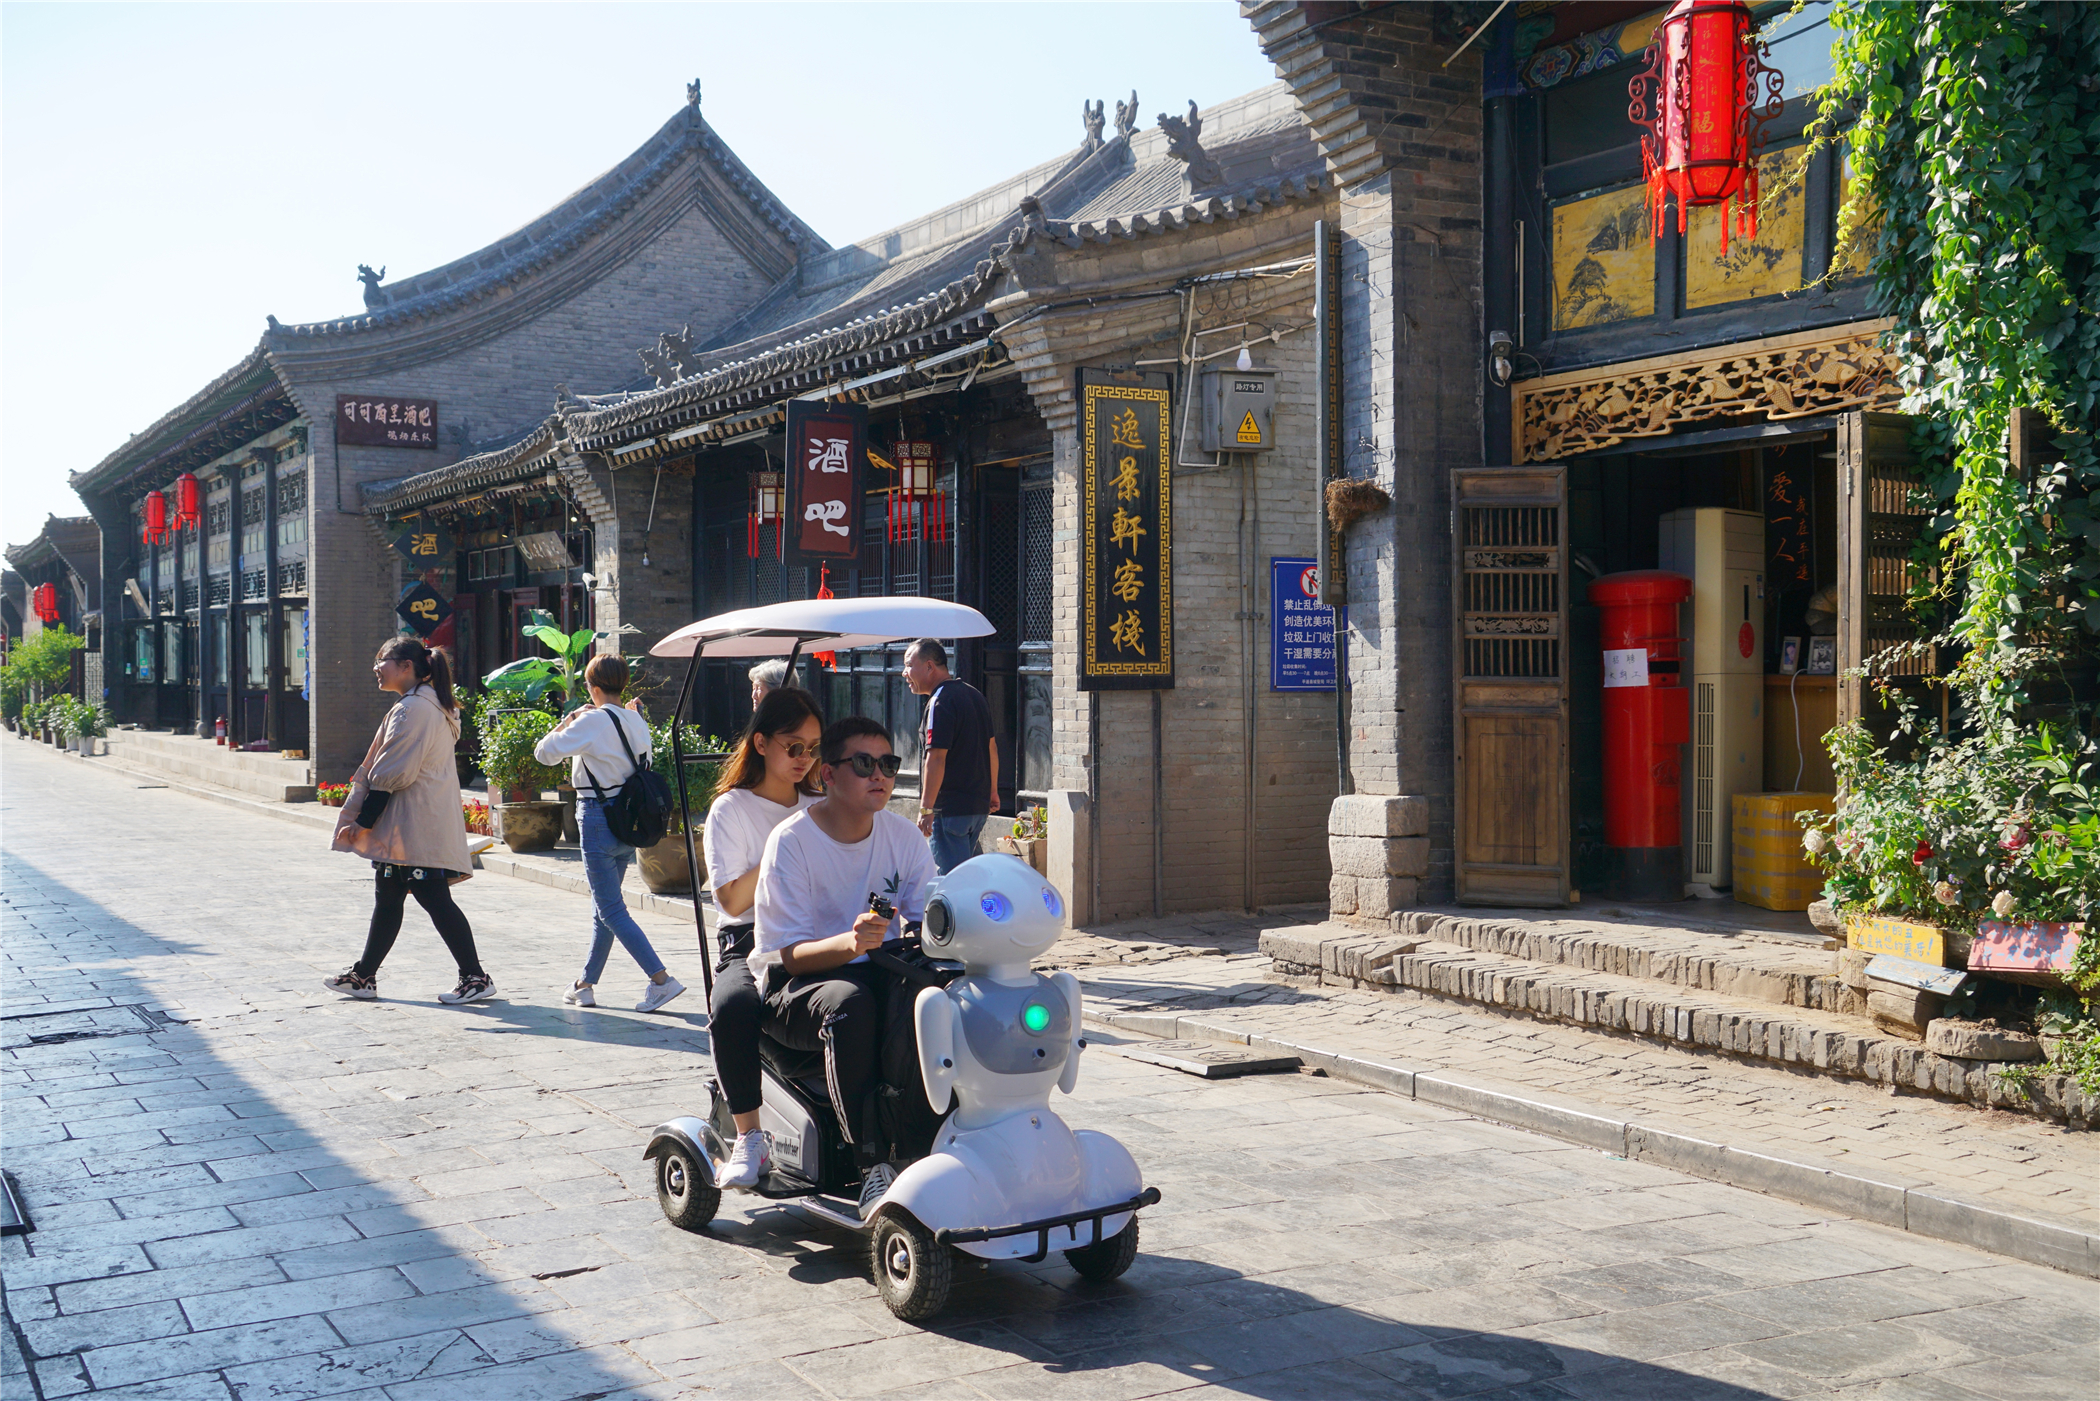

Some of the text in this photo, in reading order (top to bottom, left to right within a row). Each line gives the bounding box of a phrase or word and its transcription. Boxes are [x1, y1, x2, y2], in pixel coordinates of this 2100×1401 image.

[1235, 383, 1263, 391] 路灯专用
[804, 438, 850, 537] 酒吧
[1283, 599, 1335, 611] 禁止乱倒垃
